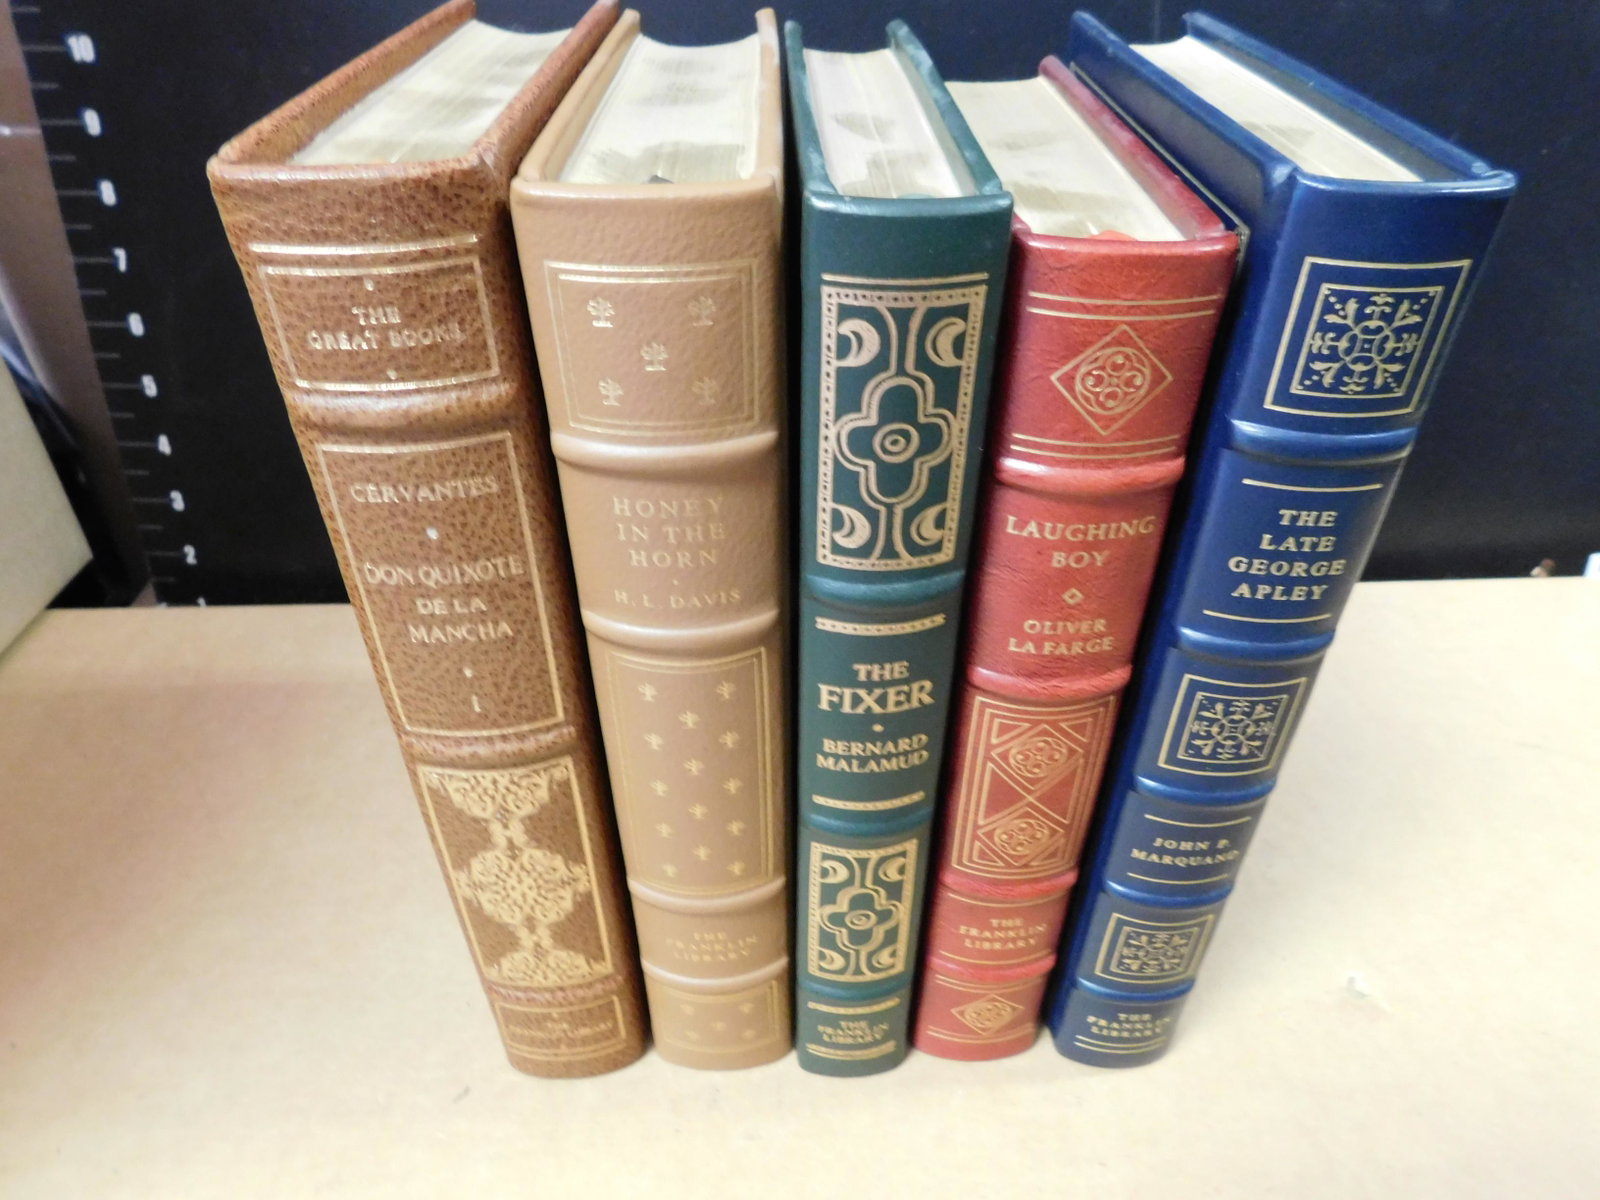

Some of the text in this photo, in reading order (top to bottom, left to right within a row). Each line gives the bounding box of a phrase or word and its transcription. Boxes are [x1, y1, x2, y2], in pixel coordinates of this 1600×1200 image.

[351, 305, 401, 326] THE
[306, 329, 379, 350] GREAT
[350, 475, 499, 504] CERVANTES
[612, 495, 724, 520] HONEY
[1278, 508, 1338, 527] THE
[615, 522, 727, 545] IN THE
[1006, 514, 1156, 542] LAUGHING
[1259, 533, 1337, 552] LATE
[183, 544, 198, 565] 2
[628, 548, 718, 569] HORN
[1051, 549, 1110, 569] BOY
[363, 555, 525, 590] DON QUIXOTE
[1227, 555, 1347, 578] GEORGE
[669, 589, 742, 610] DAVIS
[1230, 582, 1329, 601] APLEY
[415, 598, 488, 616] DE LA
[408, 622, 513, 644] MANCHA
[1023, 618, 1107, 636] OLIVER
[1007, 636, 1115, 656] LA FARGE
[852, 660, 910, 682] THE
[817, 679, 936, 715] FIXER
[822, 733, 929, 757] BERNARD
[816, 749, 929, 774] MALAMUD
[1152, 837, 1211, 851] JOHN
